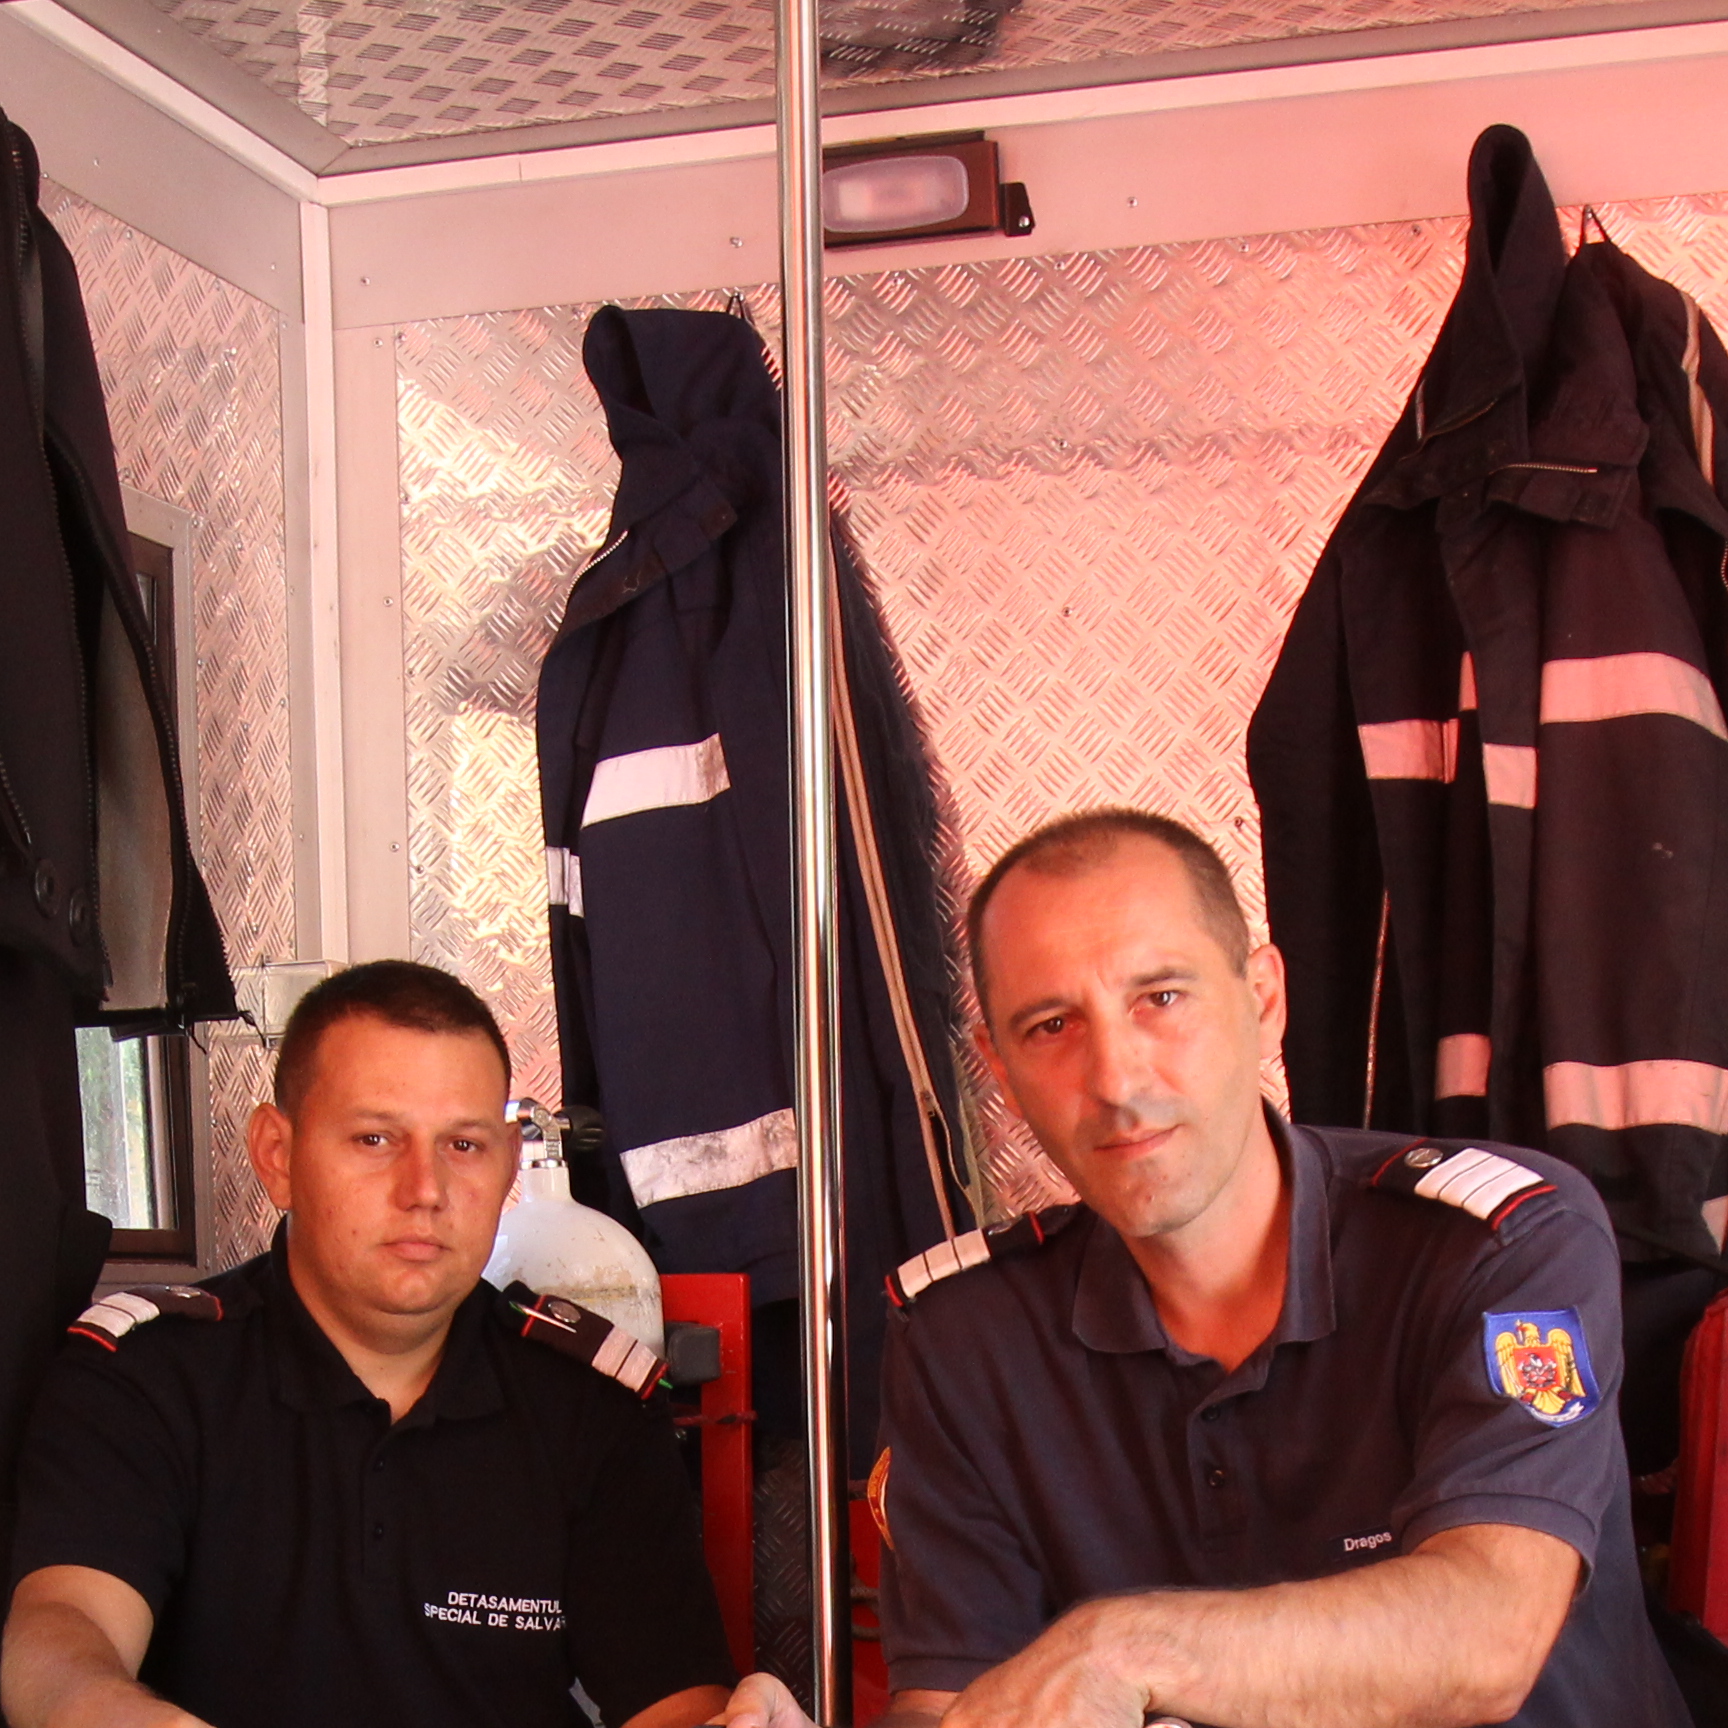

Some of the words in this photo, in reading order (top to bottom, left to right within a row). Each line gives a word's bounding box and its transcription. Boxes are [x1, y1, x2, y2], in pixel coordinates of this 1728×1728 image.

[1343, 1531, 1392, 1552] Dragos
[447, 1591, 563, 1614] DETASAMENTUL
[424, 1602, 482, 1625] SPECIAL
[487, 1612, 509, 1628] DE
